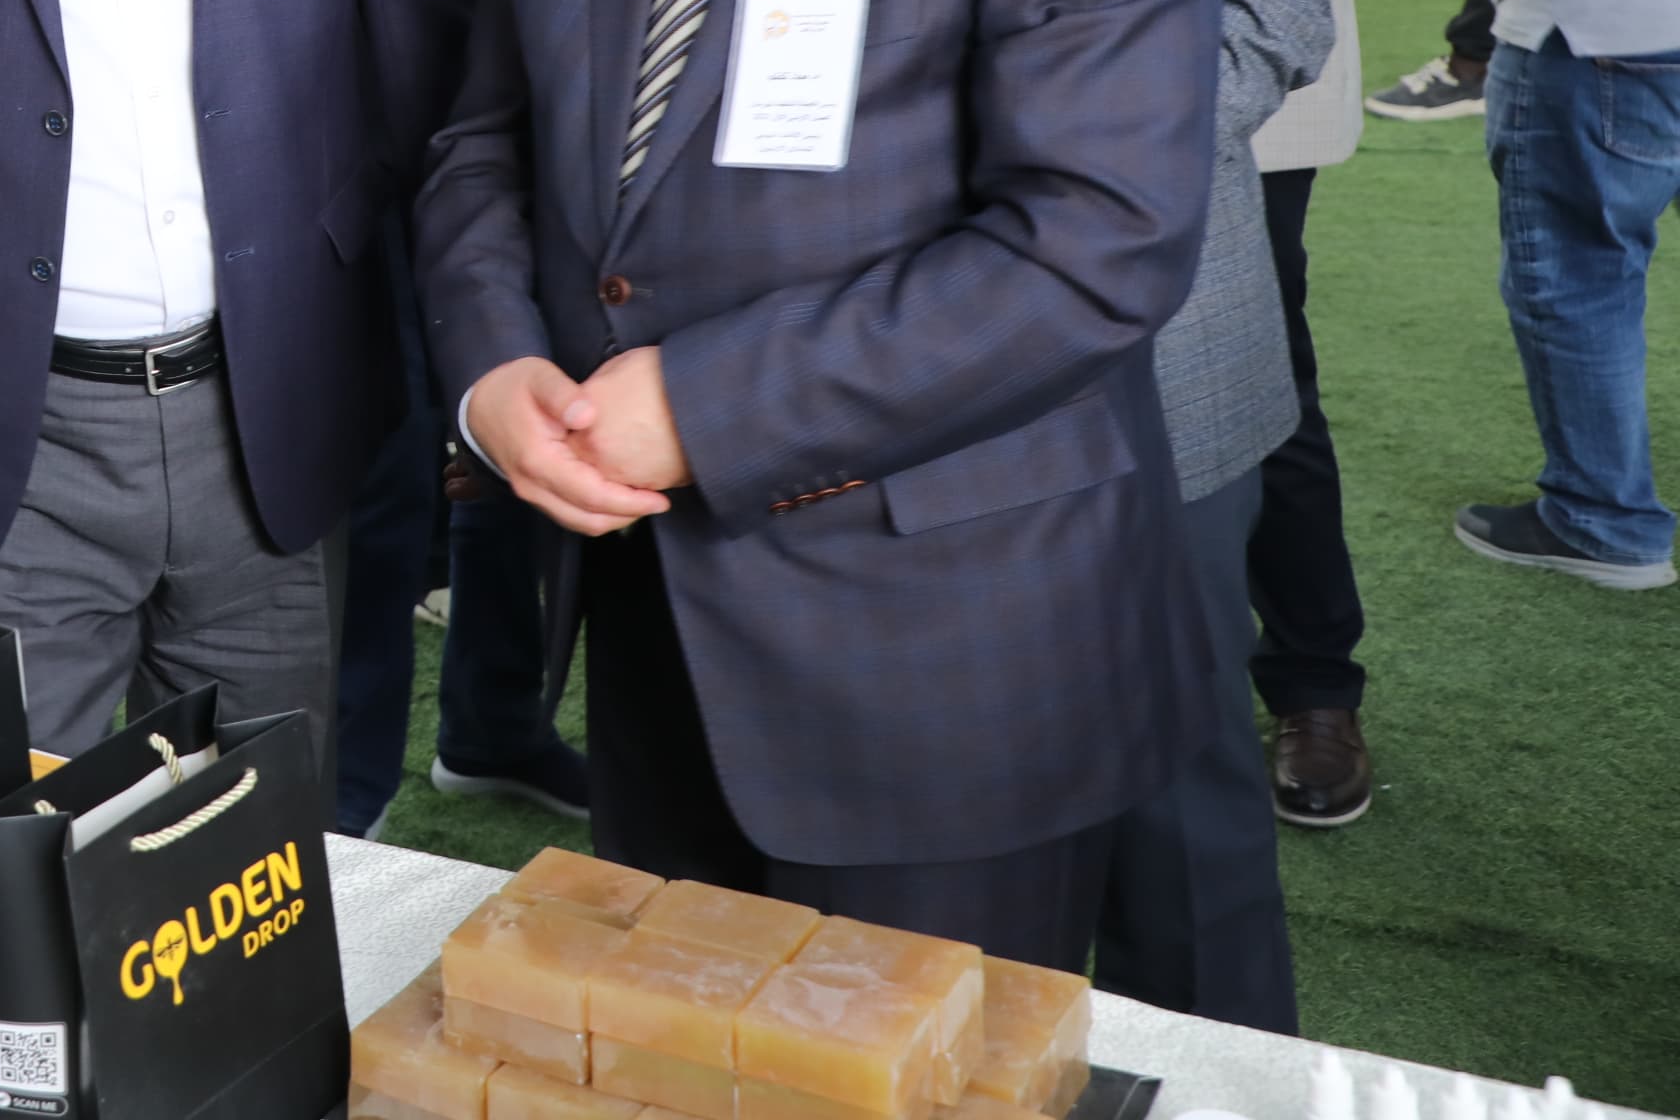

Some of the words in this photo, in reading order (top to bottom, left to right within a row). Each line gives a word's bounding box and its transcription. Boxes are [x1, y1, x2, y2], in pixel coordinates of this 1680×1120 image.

[120, 841, 303, 1006] GOLDEN
[242, 898, 305, 959] DROP
[12, 1096, 40, 1111] SCAN
[40, 1100, 57, 1112] ME
